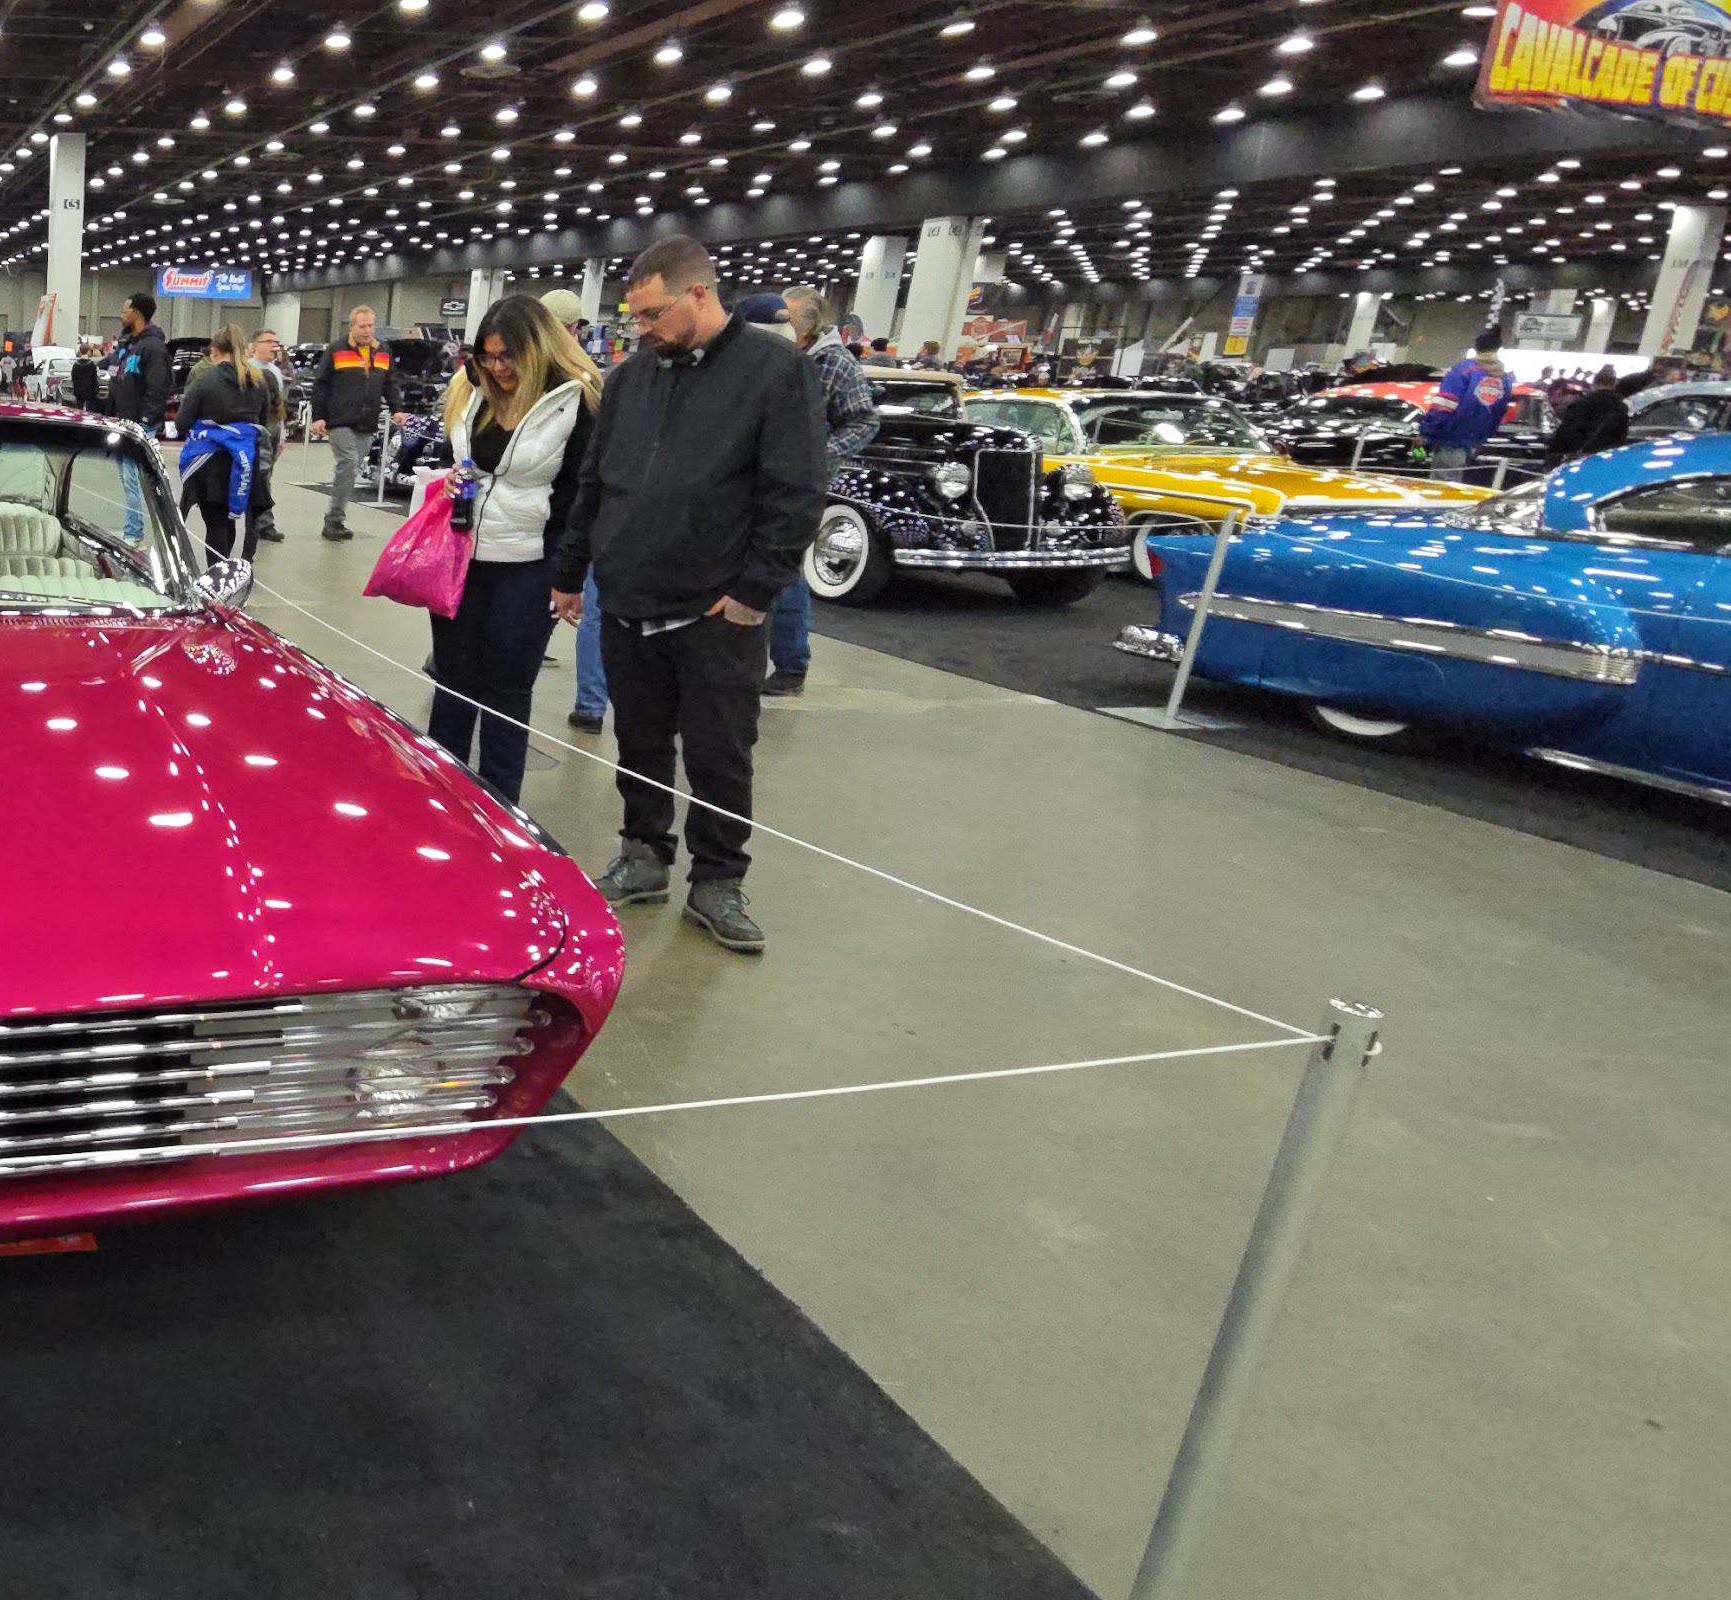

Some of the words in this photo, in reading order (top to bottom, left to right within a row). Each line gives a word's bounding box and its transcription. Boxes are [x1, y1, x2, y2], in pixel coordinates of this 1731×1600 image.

[1489, 2, 1660, 105] CAVALCADE
[1659, 55, 1700, 107] OF
[237, 450, 251, 496] PlayStation
